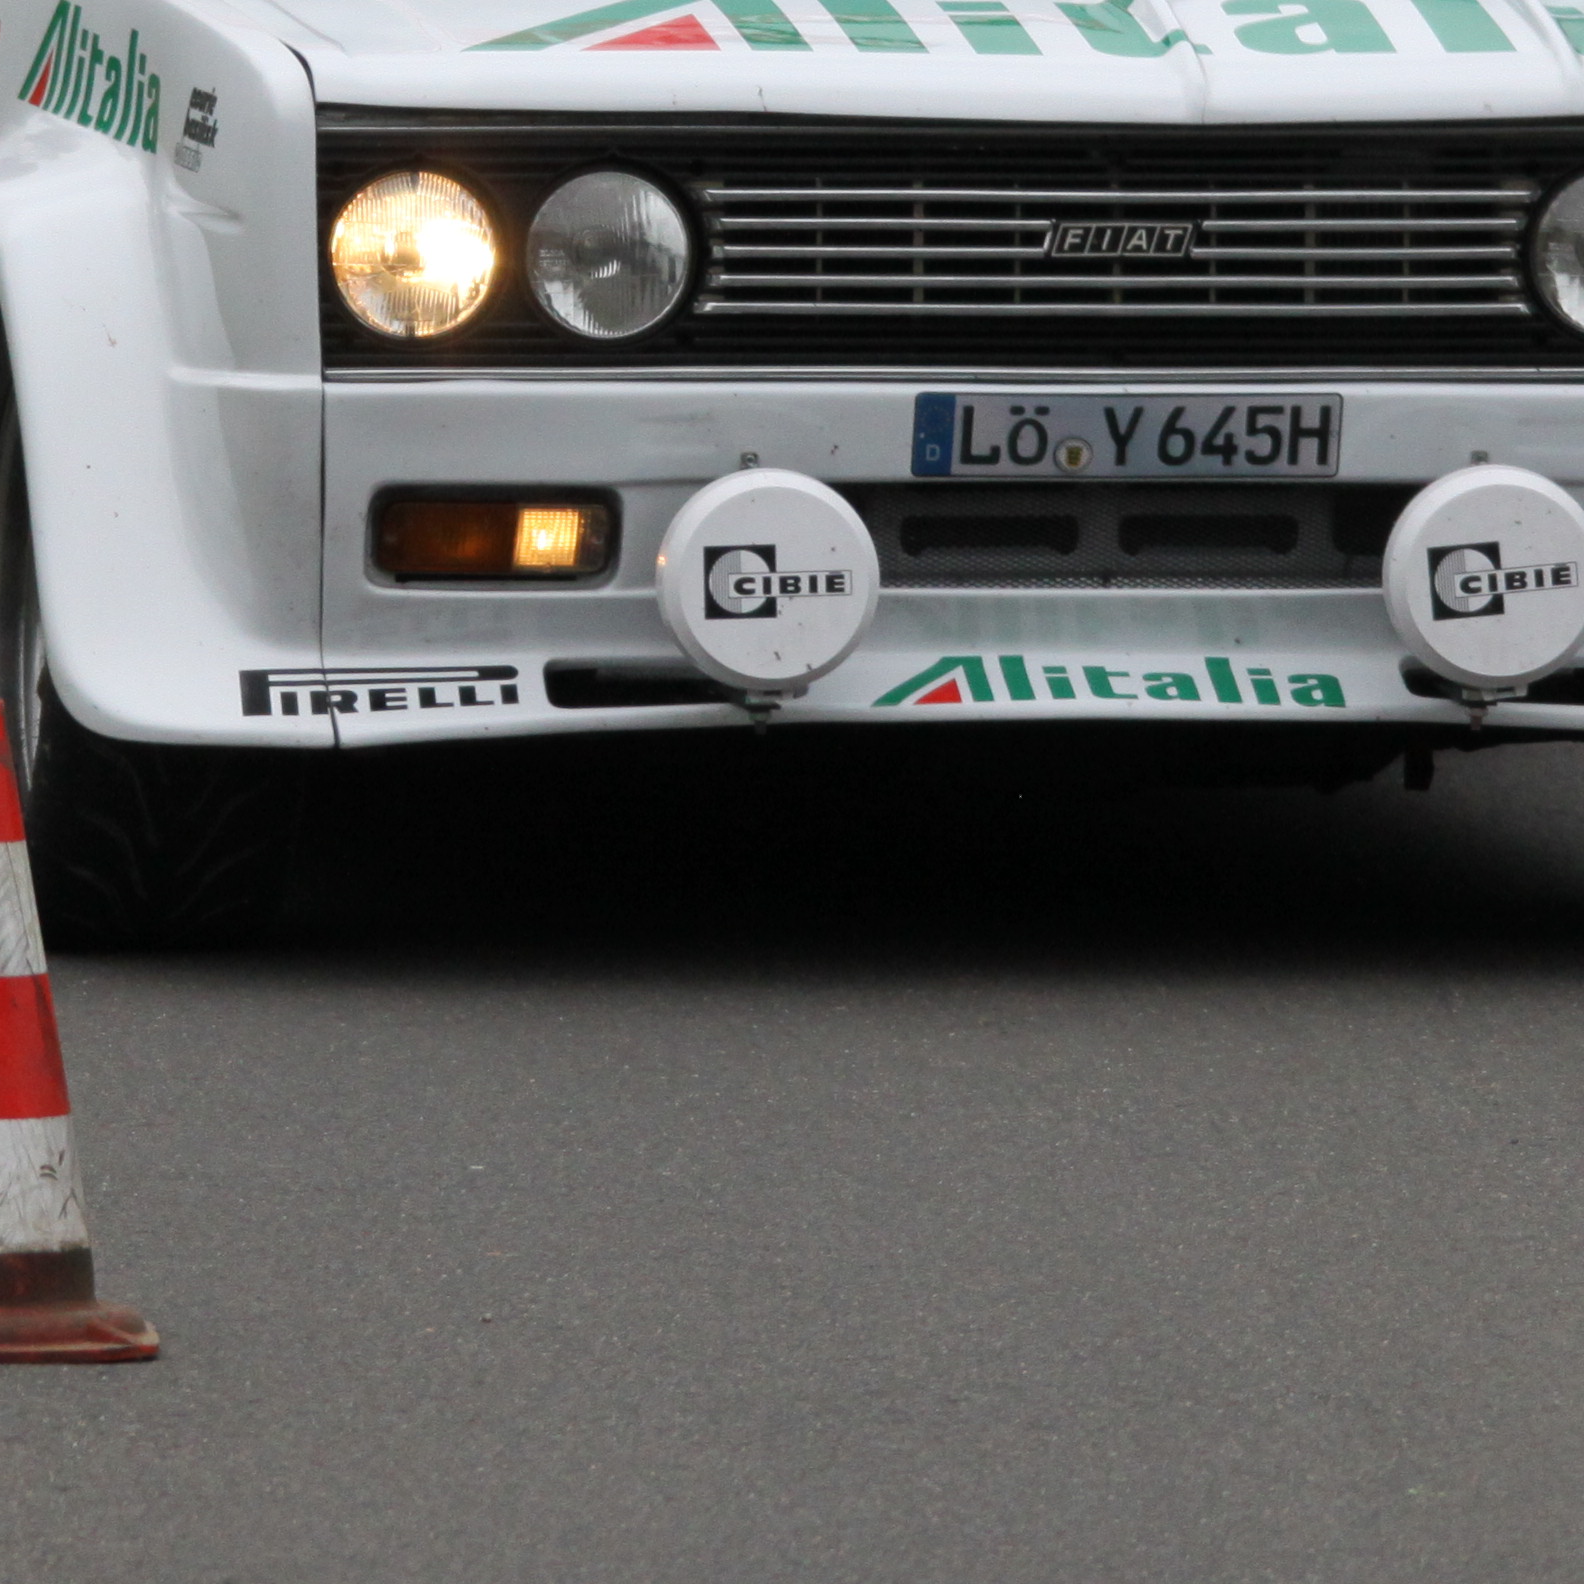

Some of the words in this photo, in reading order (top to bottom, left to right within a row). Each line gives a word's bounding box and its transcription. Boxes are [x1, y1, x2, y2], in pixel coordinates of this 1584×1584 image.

[1061, 228, 1184, 253] FIAT
[925, 443, 941, 462] D
[960, 405, 1051, 466] LÖ
[1103, 406, 1145, 467] Y
[1156, 404, 1333, 467] 645H
[239, 664, 520, 717] PIRELLI
[871, 654, 1347, 708] Alitalia
